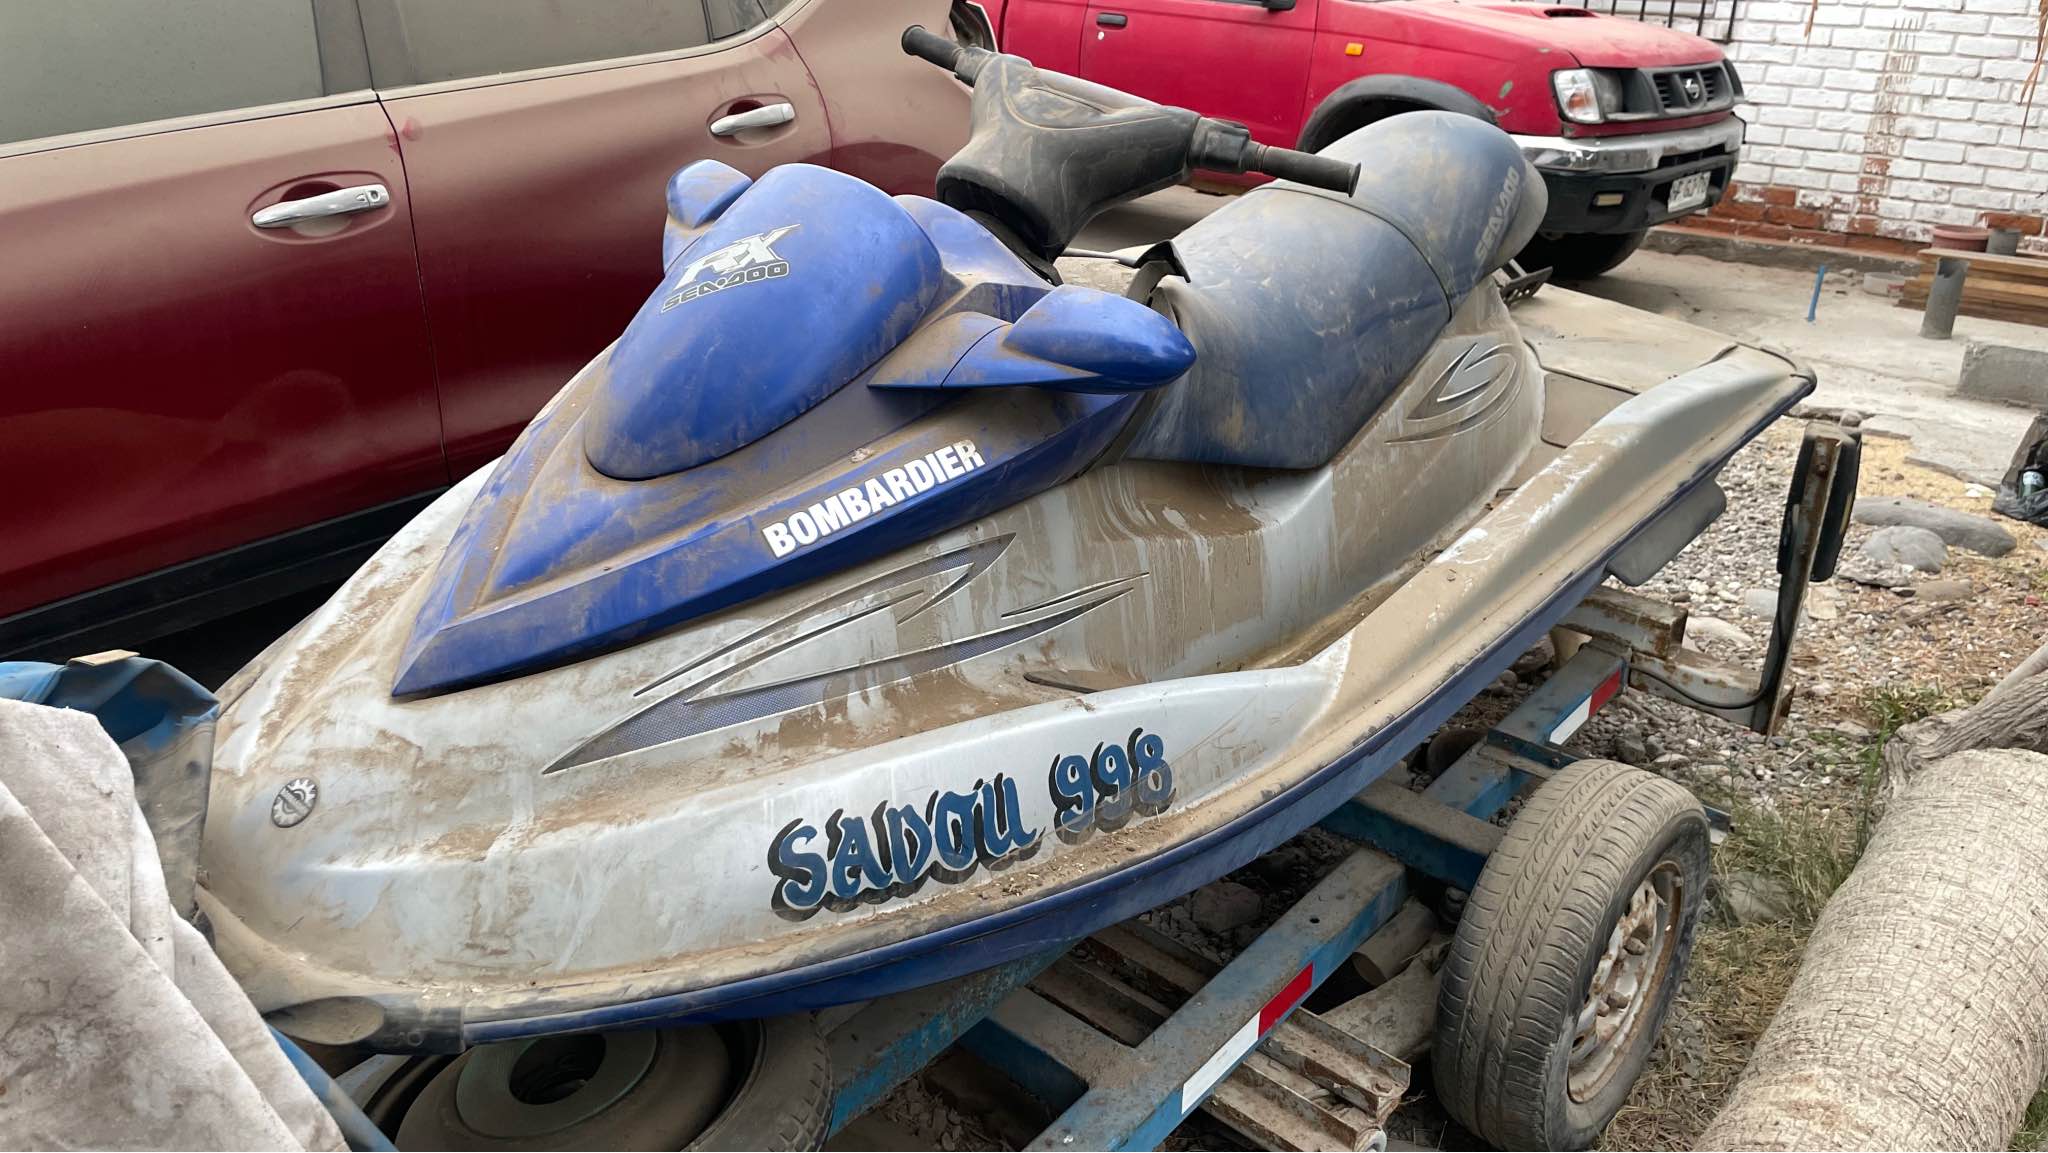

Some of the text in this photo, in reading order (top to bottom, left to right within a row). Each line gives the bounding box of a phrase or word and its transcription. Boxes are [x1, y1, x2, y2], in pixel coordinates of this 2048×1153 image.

[673, 224, 800, 290] RX
[762, 440, 985, 558] BOMBARDIER
[1049, 728, 1176, 844] 998
